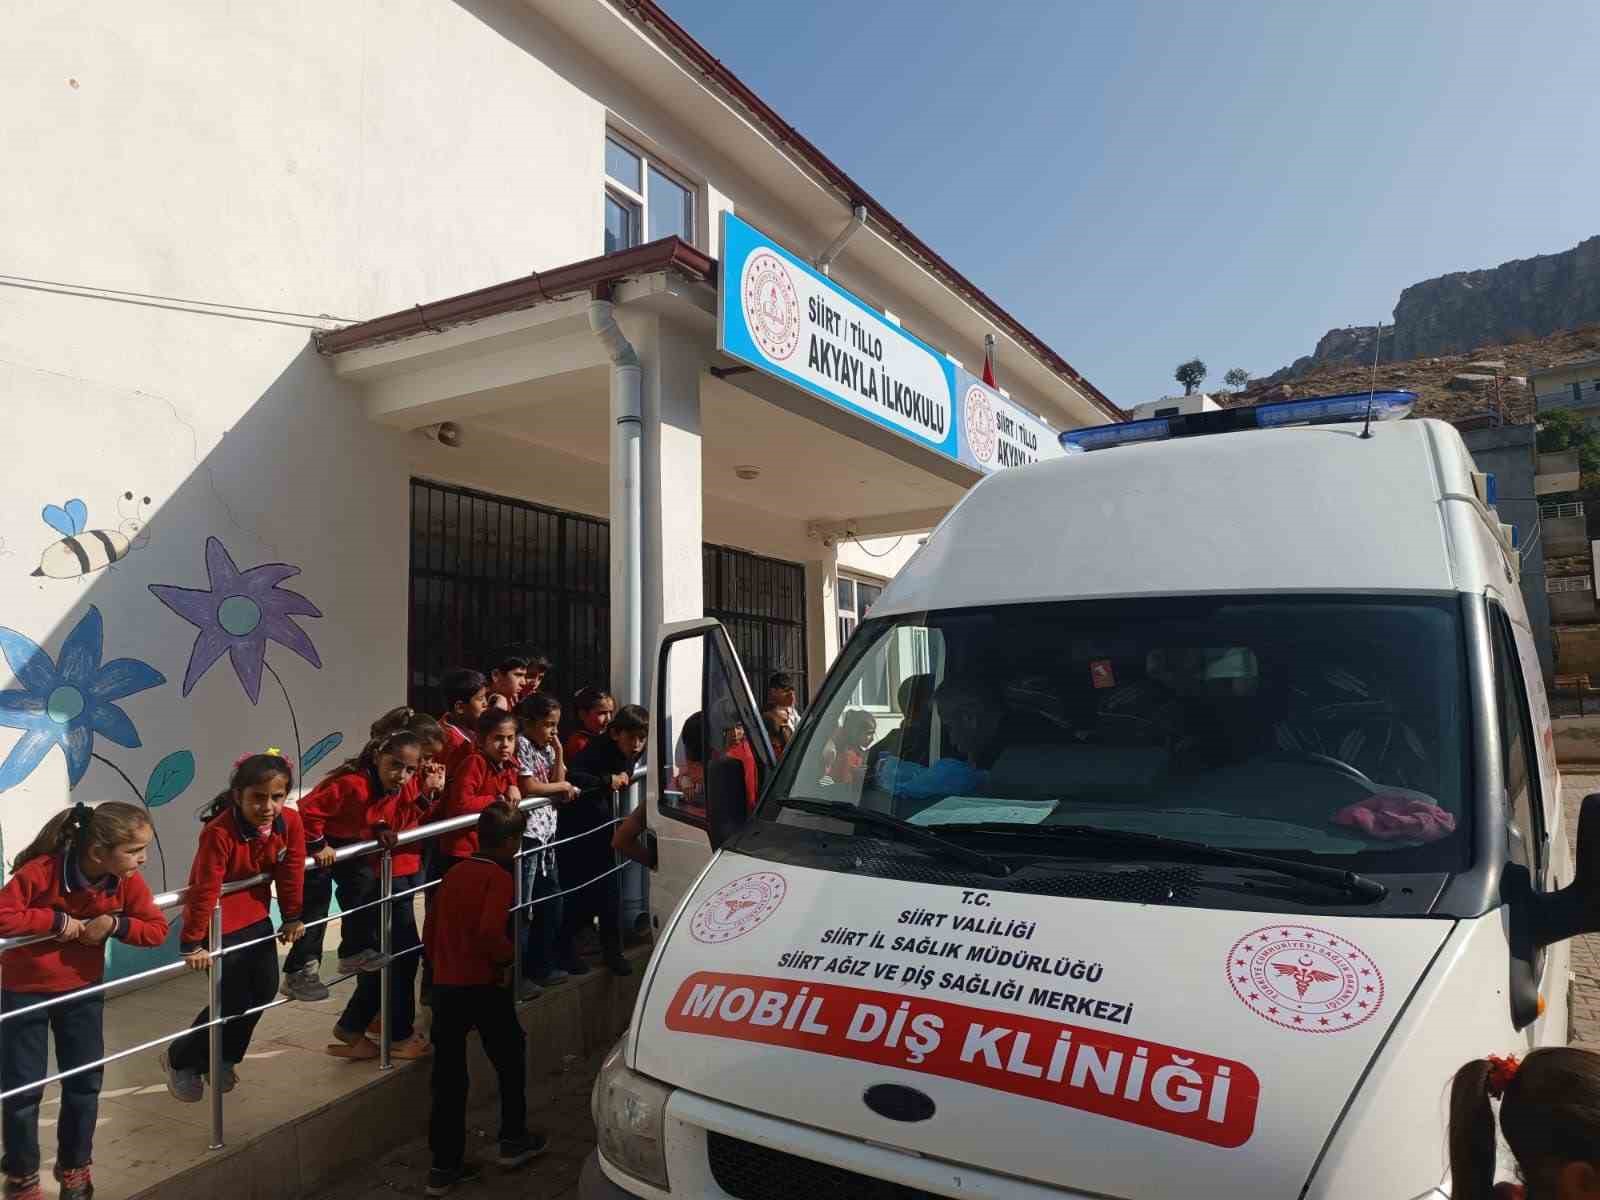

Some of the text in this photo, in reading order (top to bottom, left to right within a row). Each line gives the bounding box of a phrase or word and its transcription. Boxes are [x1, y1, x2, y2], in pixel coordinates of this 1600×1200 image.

[808, 295, 841, 337] SİİRT
[850, 321, 882, 362] TİLLO
[808, 333, 878, 402] AKYAYLA
[881, 365, 944, 435] İLKOKULU
[996, 409, 1014, 438] SİİRT
[1018, 423, 1037, 451] TİLLO
[898, 908, 1036, 940] SİİRT VALİLİĞİ
[961, 891, 992, 907] T.C.
[820, 926, 1104, 984] SİİRT İL SAĞLIK MÜDÜRLÜĞÜ
[777, 949, 1134, 1025] SİİRT AĞIZ VE DİŞ SAĞLIĞI MERKEZİ
[680, 986, 1232, 1124] MOBİL DİŞ KLİNİĞİ
